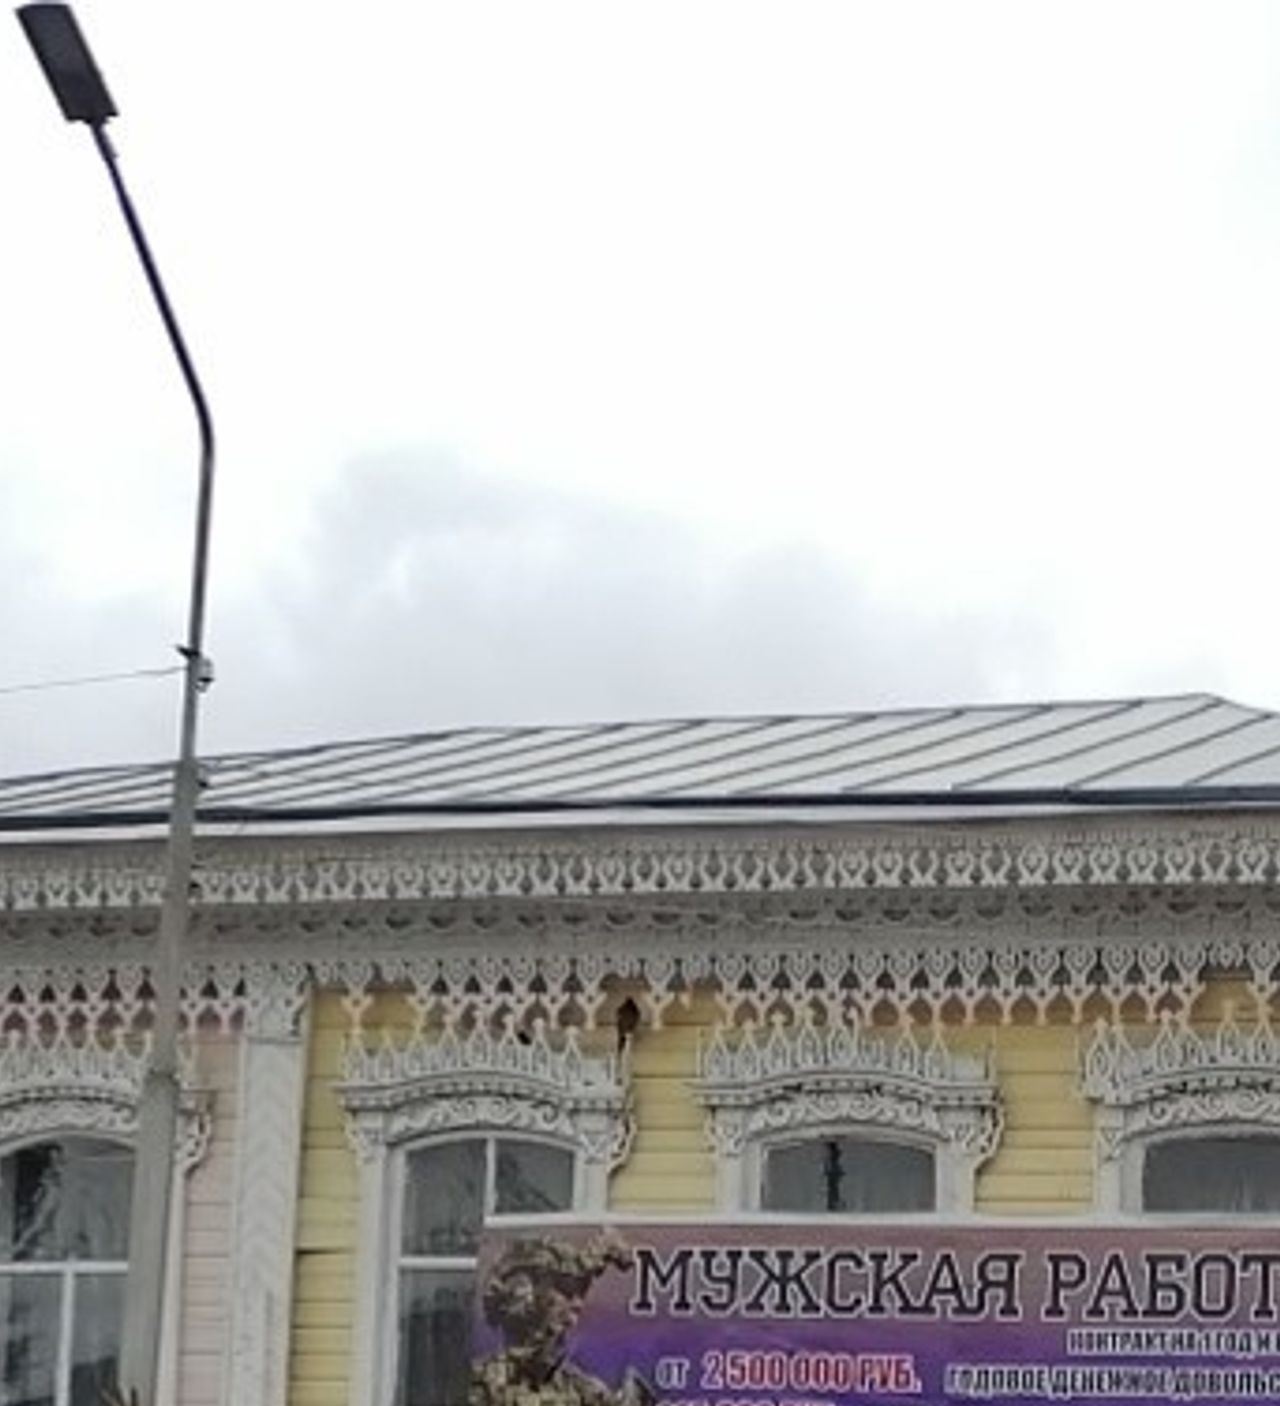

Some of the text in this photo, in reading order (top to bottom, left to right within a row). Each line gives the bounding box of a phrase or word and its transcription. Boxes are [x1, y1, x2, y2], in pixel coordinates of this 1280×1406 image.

[632, 1248, 1021, 1320] МУЖСКАЯ
[1068, 1329, 1164, 1355] КОНТРАКТ
[1170, 1330, 1197, 1355] НА
[1214, 1331, 1250, 1358] ГОД
[701, 1350, 723, 1389] 2
[725, 1350, 787, 1391] 500
[789, 1351, 852, 1392] 000
[855, 1354, 922, 1393] РУБ.
[944, 1364, 1048, 1398] ГОДОВОЕ
[1049, 1366, 1170, 1399] ДЕНЕЖНОЕ
